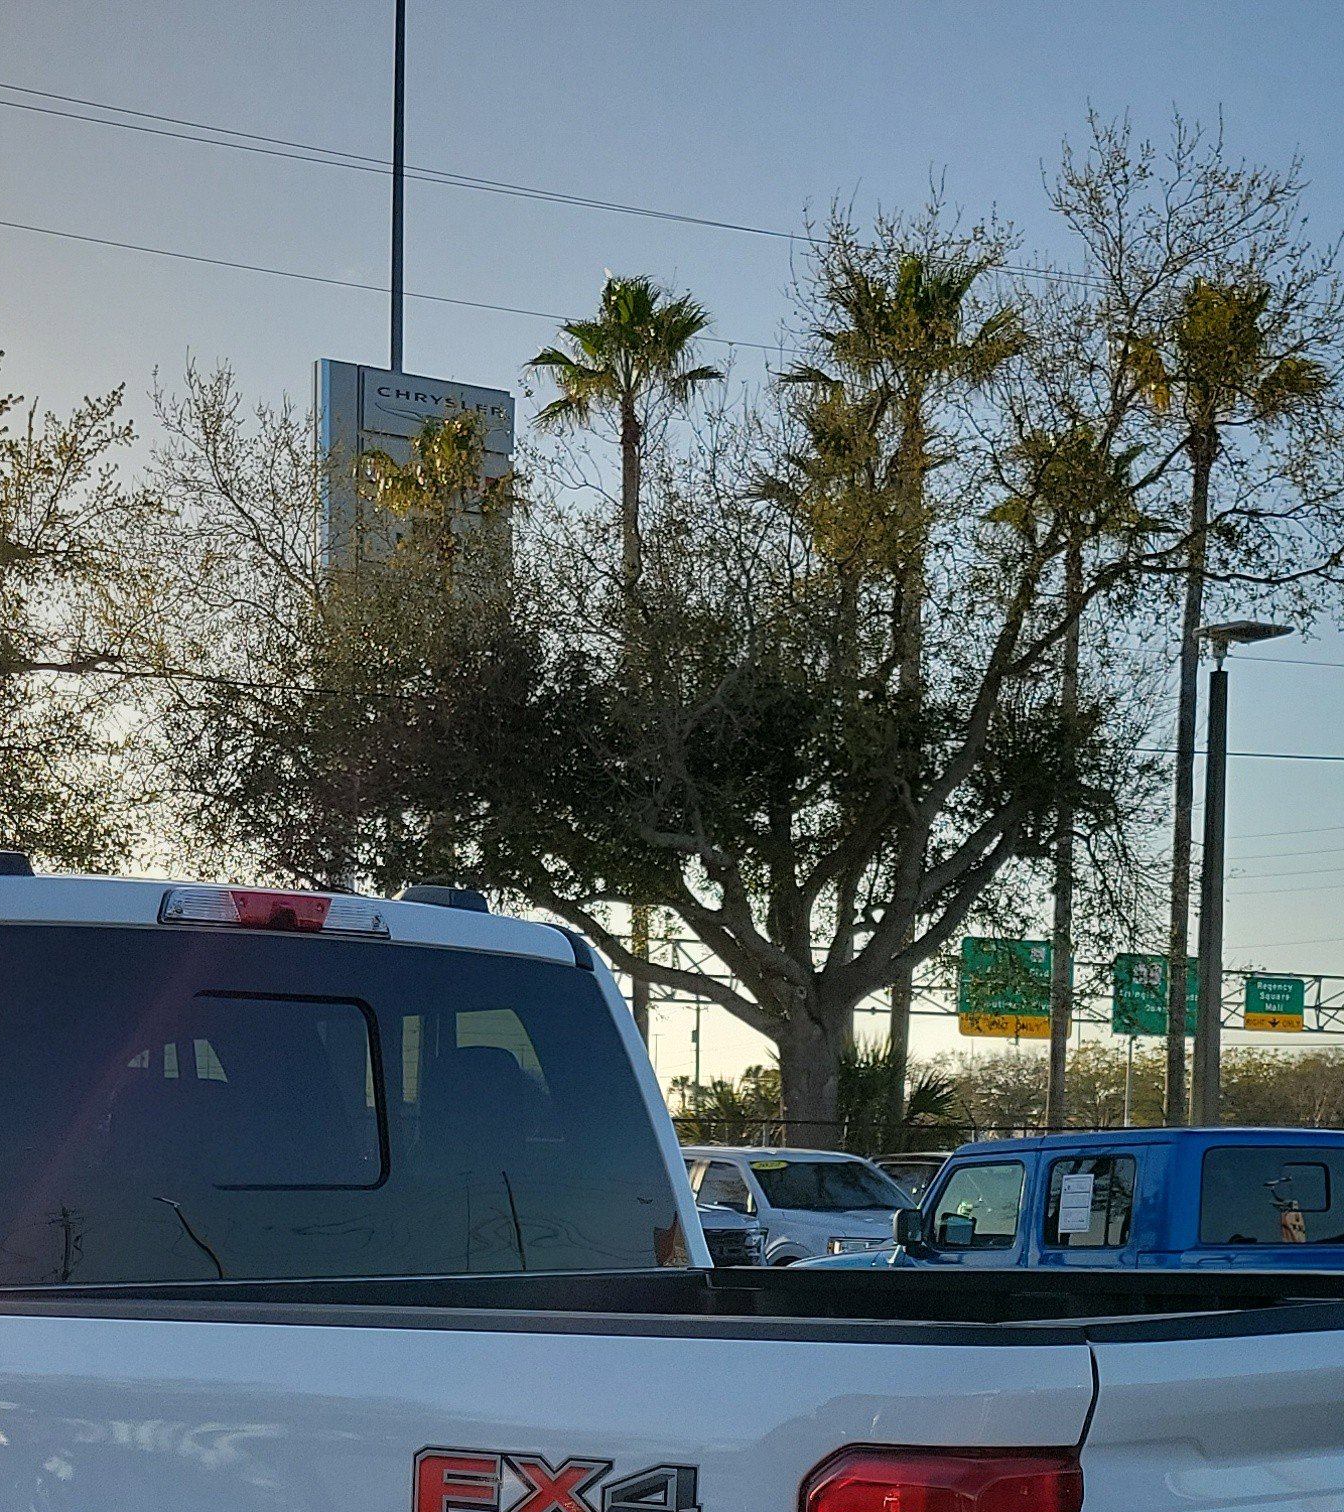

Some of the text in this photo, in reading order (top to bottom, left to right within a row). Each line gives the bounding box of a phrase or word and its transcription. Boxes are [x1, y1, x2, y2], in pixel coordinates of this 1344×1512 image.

[377, 386, 507, 418] CHRYSLER
[1257, 981, 1293, 992] Regency
[1259, 991, 1290, 1001] Square
[1265, 1002, 1284, 1011] Mall
